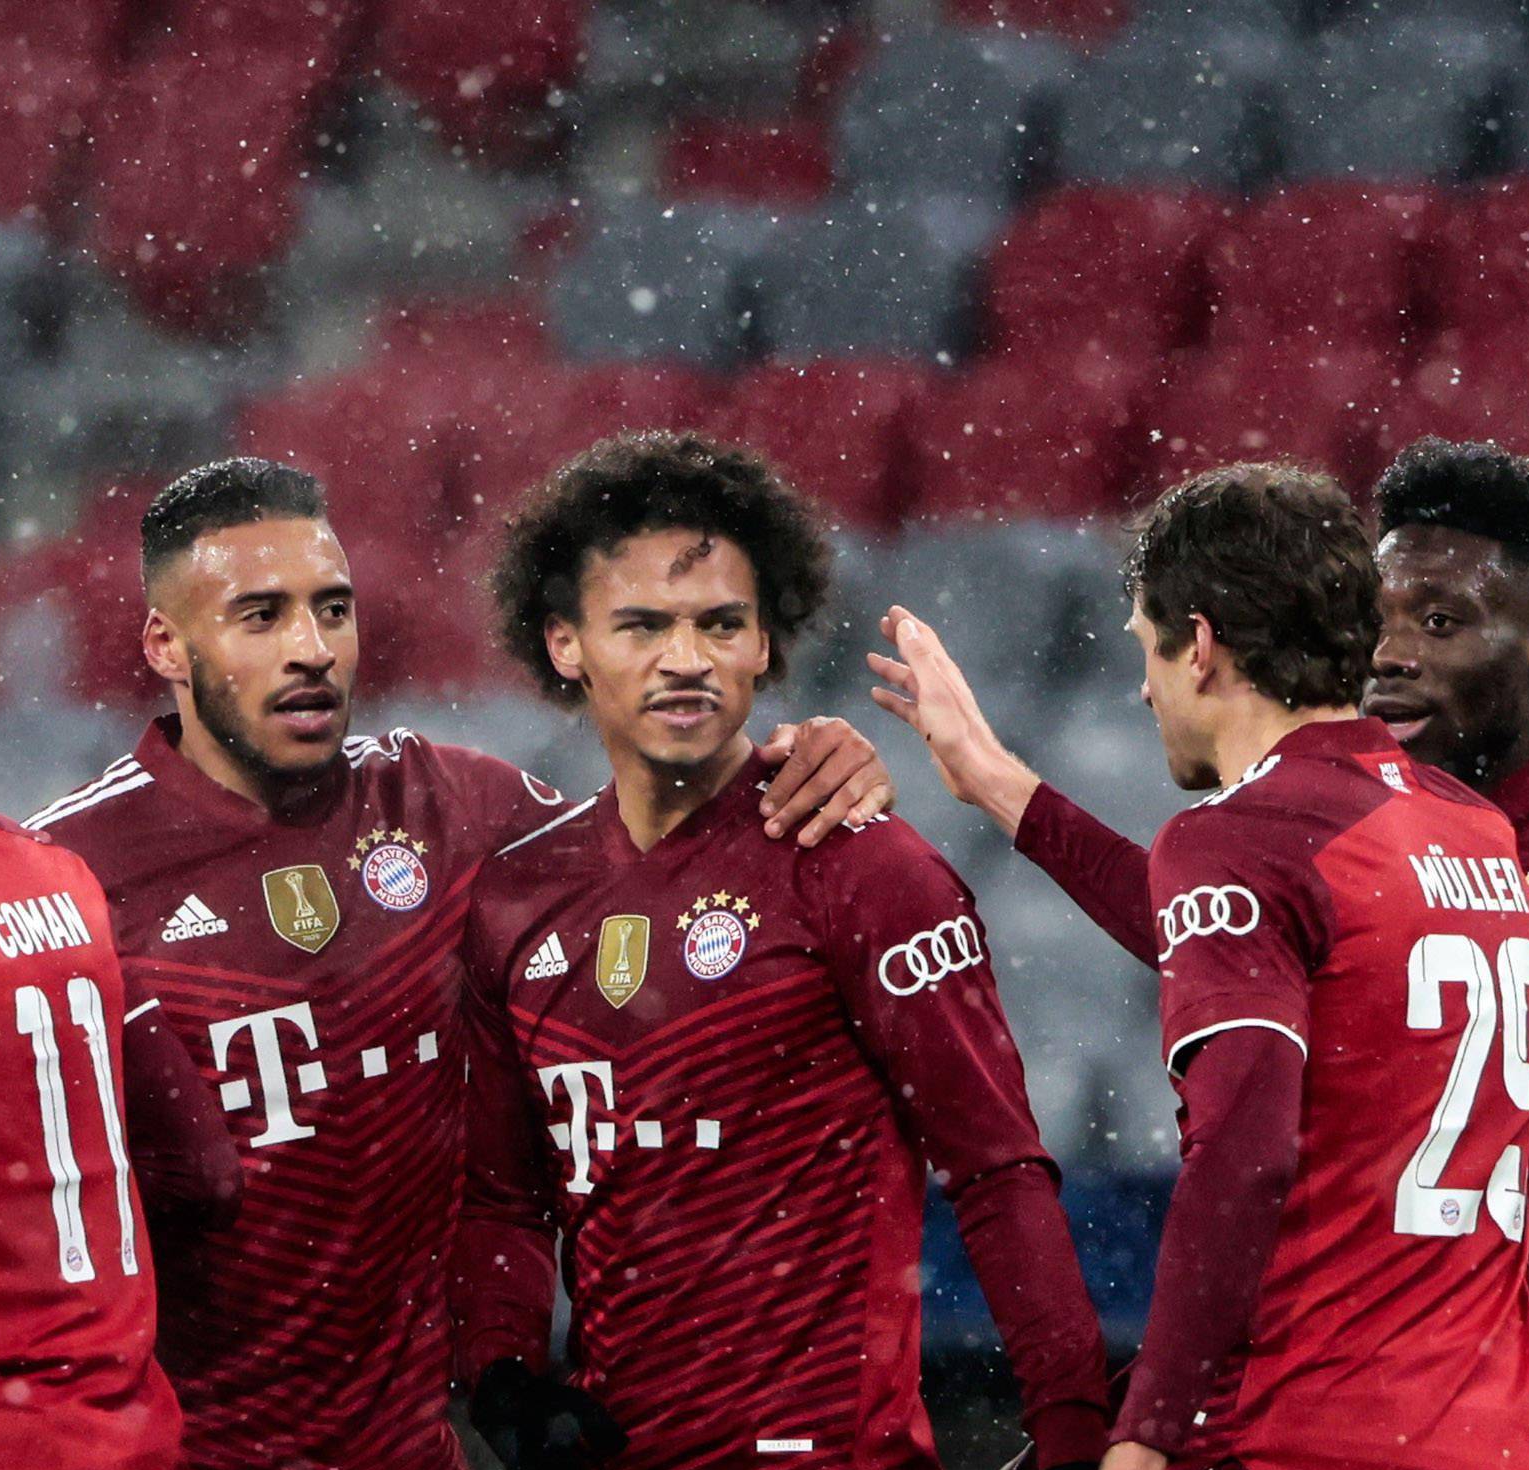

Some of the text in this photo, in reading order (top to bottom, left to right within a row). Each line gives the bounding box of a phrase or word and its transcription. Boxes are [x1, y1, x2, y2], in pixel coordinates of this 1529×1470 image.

[367, 849, 419, 880] FC BAYERN
[293, 916, 324, 932] FIFA
[690, 915, 741, 941] FC BAYERN
[609, 972, 632, 985] FIFA
[15, 977, 139, 1283] 11
